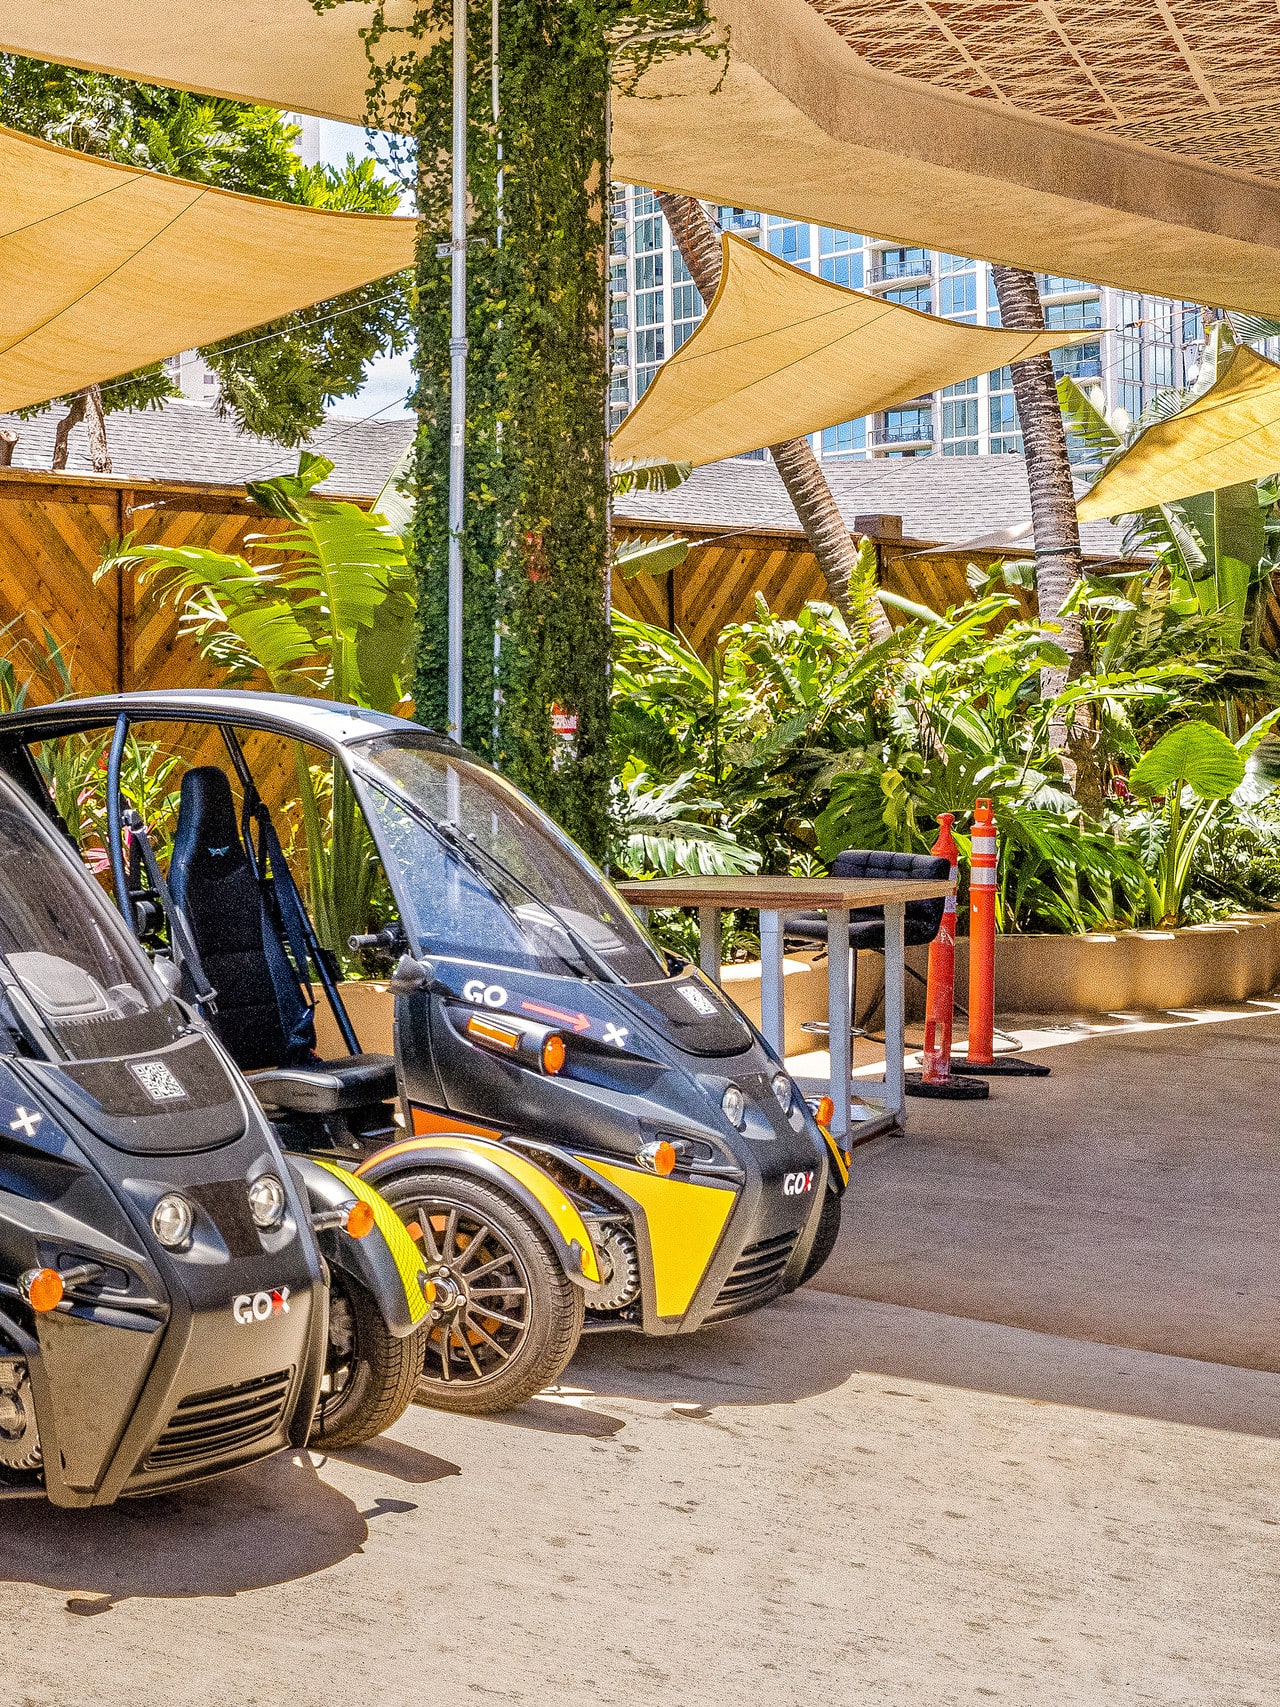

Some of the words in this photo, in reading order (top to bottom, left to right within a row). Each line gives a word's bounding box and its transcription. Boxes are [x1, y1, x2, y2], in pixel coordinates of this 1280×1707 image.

[462, 979, 508, 1008] GO
[602, 1022, 629, 1047] X
[9, 1105, 43, 1137] X
[783, 1171, 814, 1196] GOX
[233, 1286, 291, 1325] GOX
